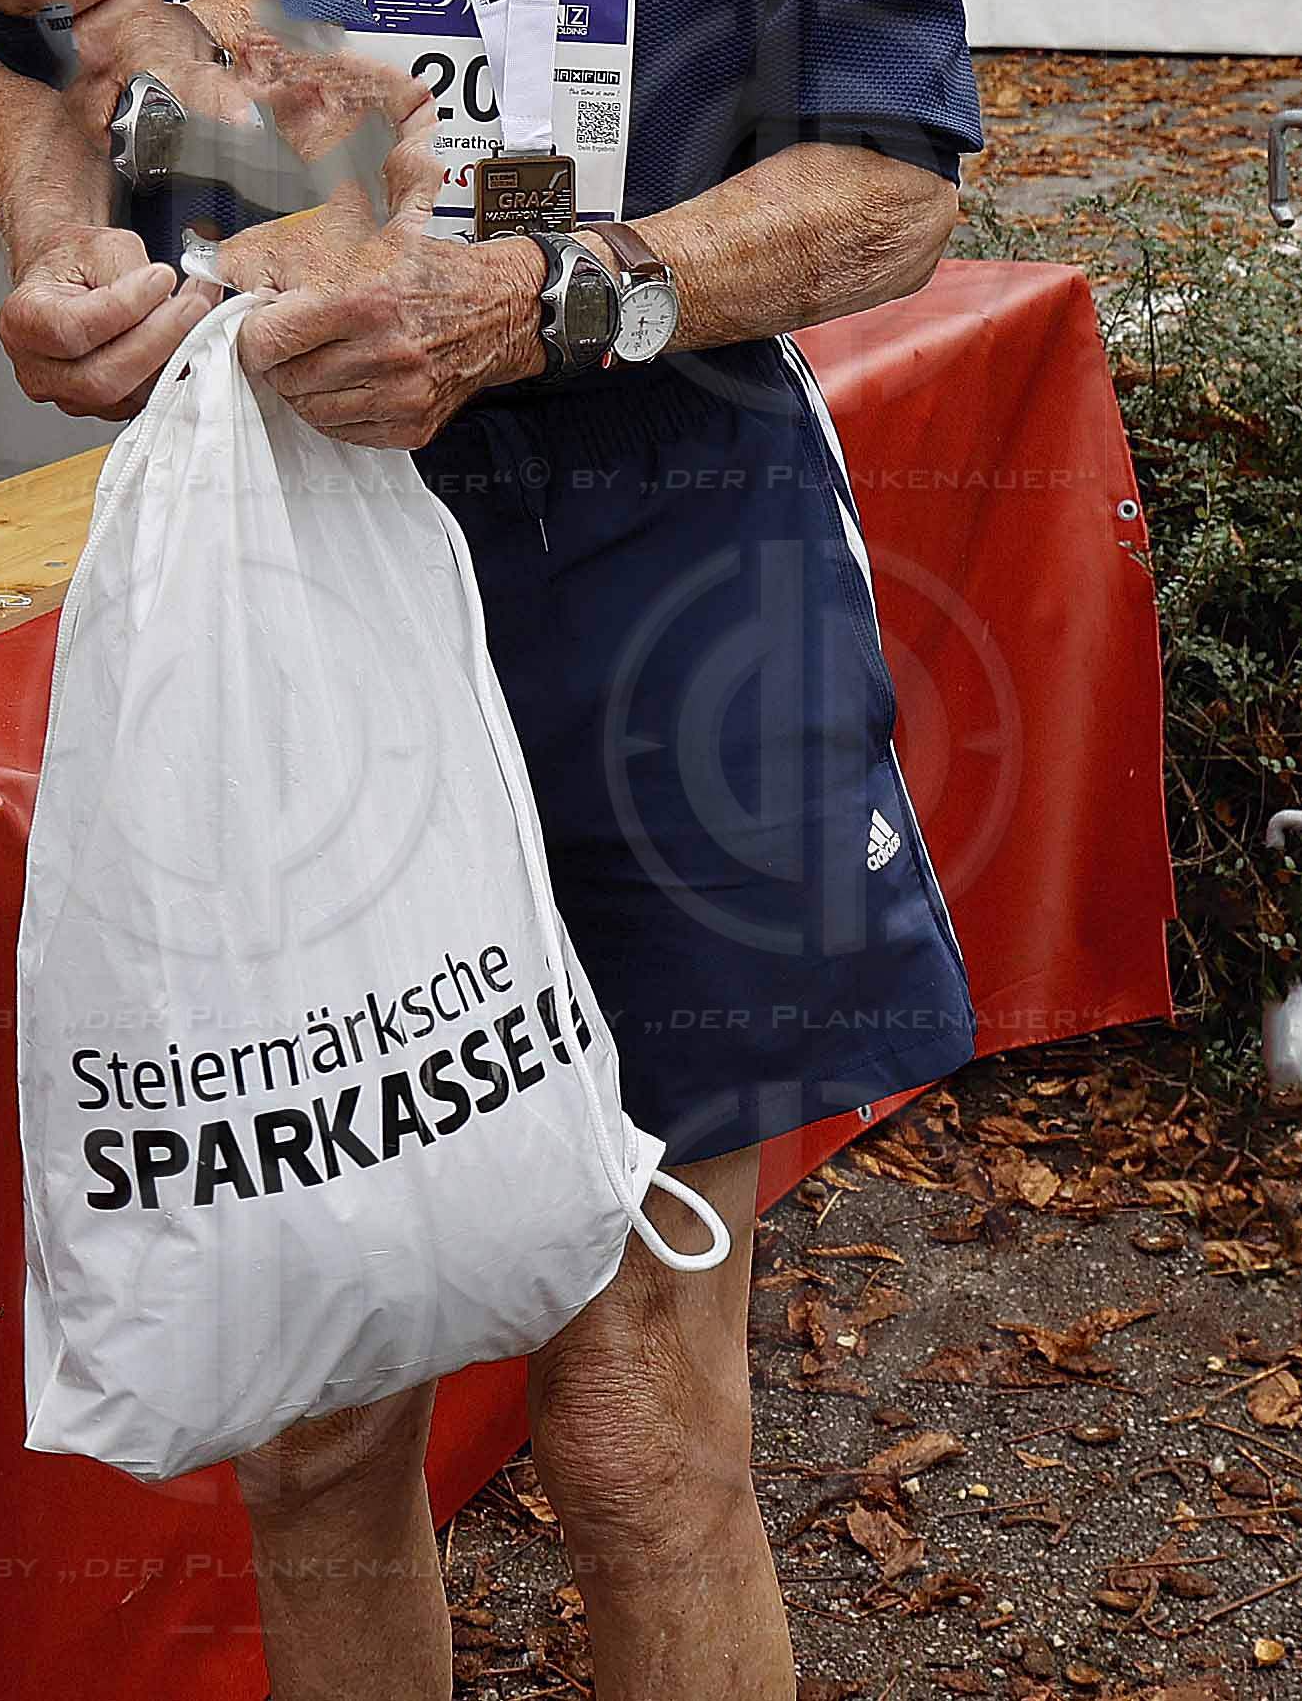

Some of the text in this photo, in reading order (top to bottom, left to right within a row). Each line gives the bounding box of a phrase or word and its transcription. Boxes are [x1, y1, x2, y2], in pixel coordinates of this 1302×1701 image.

[554, 68, 620, 85] AXFUN
[498, 191, 555, 210] GRAZ
[866, 832, 901, 871] adidas
[82, 1005, 546, 1211] SPARKASSE
